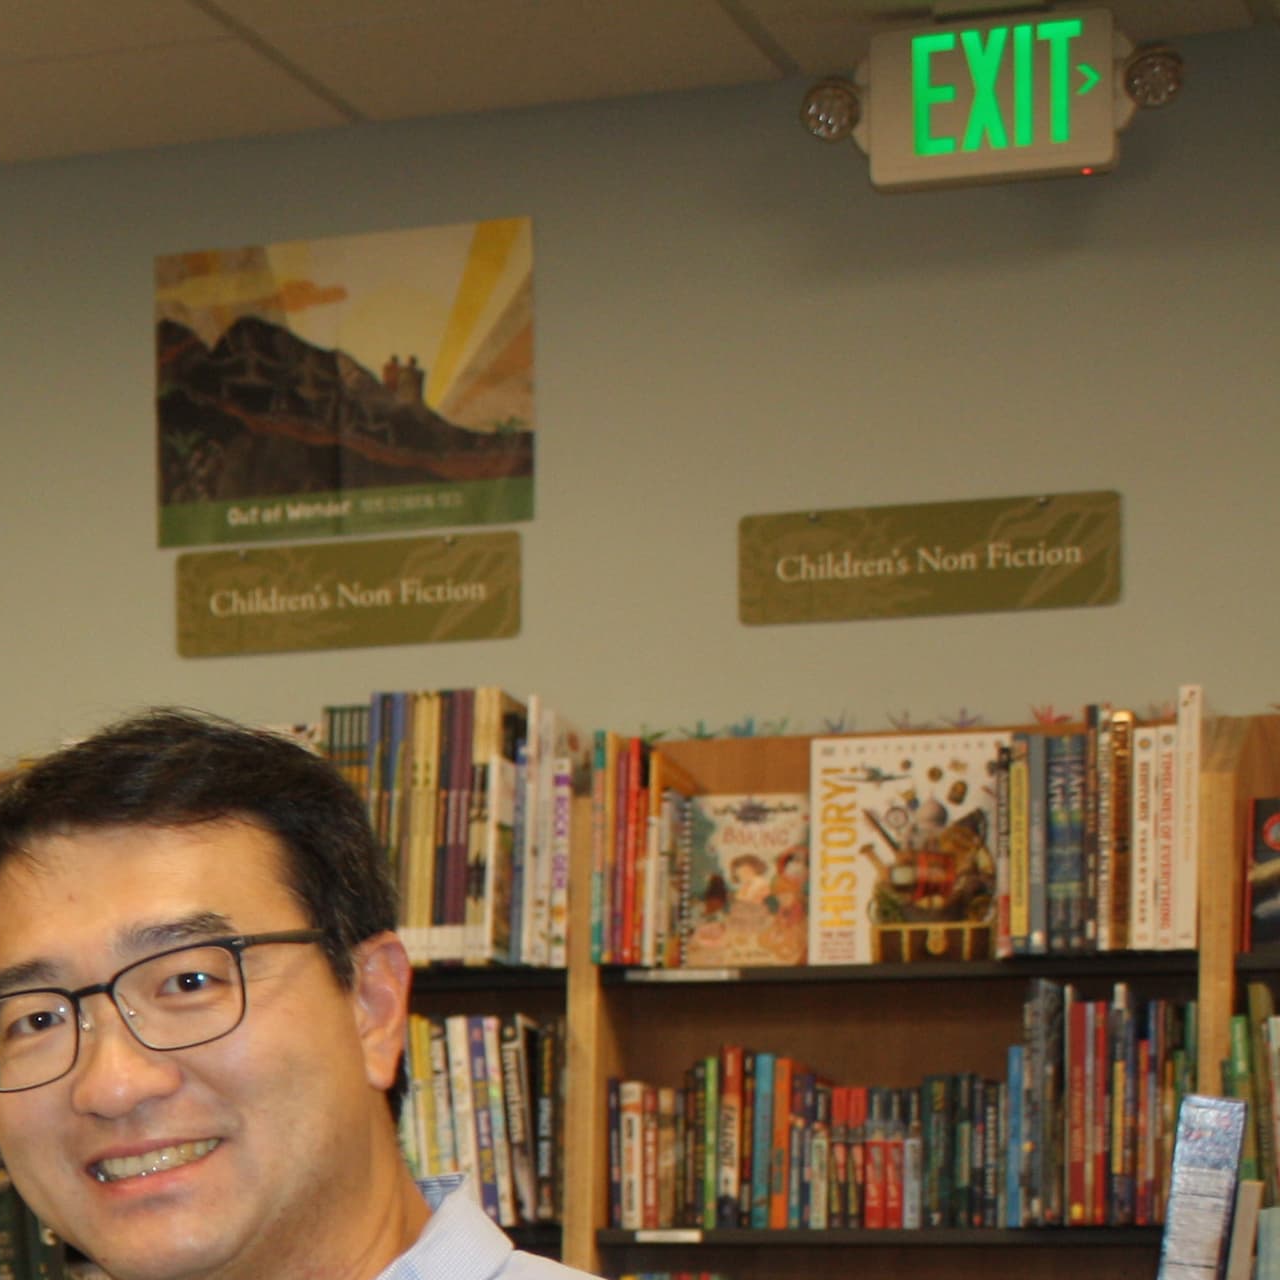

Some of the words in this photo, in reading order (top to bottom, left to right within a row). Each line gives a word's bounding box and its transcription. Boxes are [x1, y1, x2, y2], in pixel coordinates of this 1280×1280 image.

[912, 20, 1082, 156] EXIT
[226, 505, 259, 526] Out
[776, 549, 910, 583] Children's
[917, 546, 976, 575] Non
[986, 540, 1082, 569] Fiction
[209, 584, 330, 616] Children's
[336, 581, 392, 608] Non
[399, 577, 487, 605] Fiction
[818, 767, 859, 927] HISTORY!
